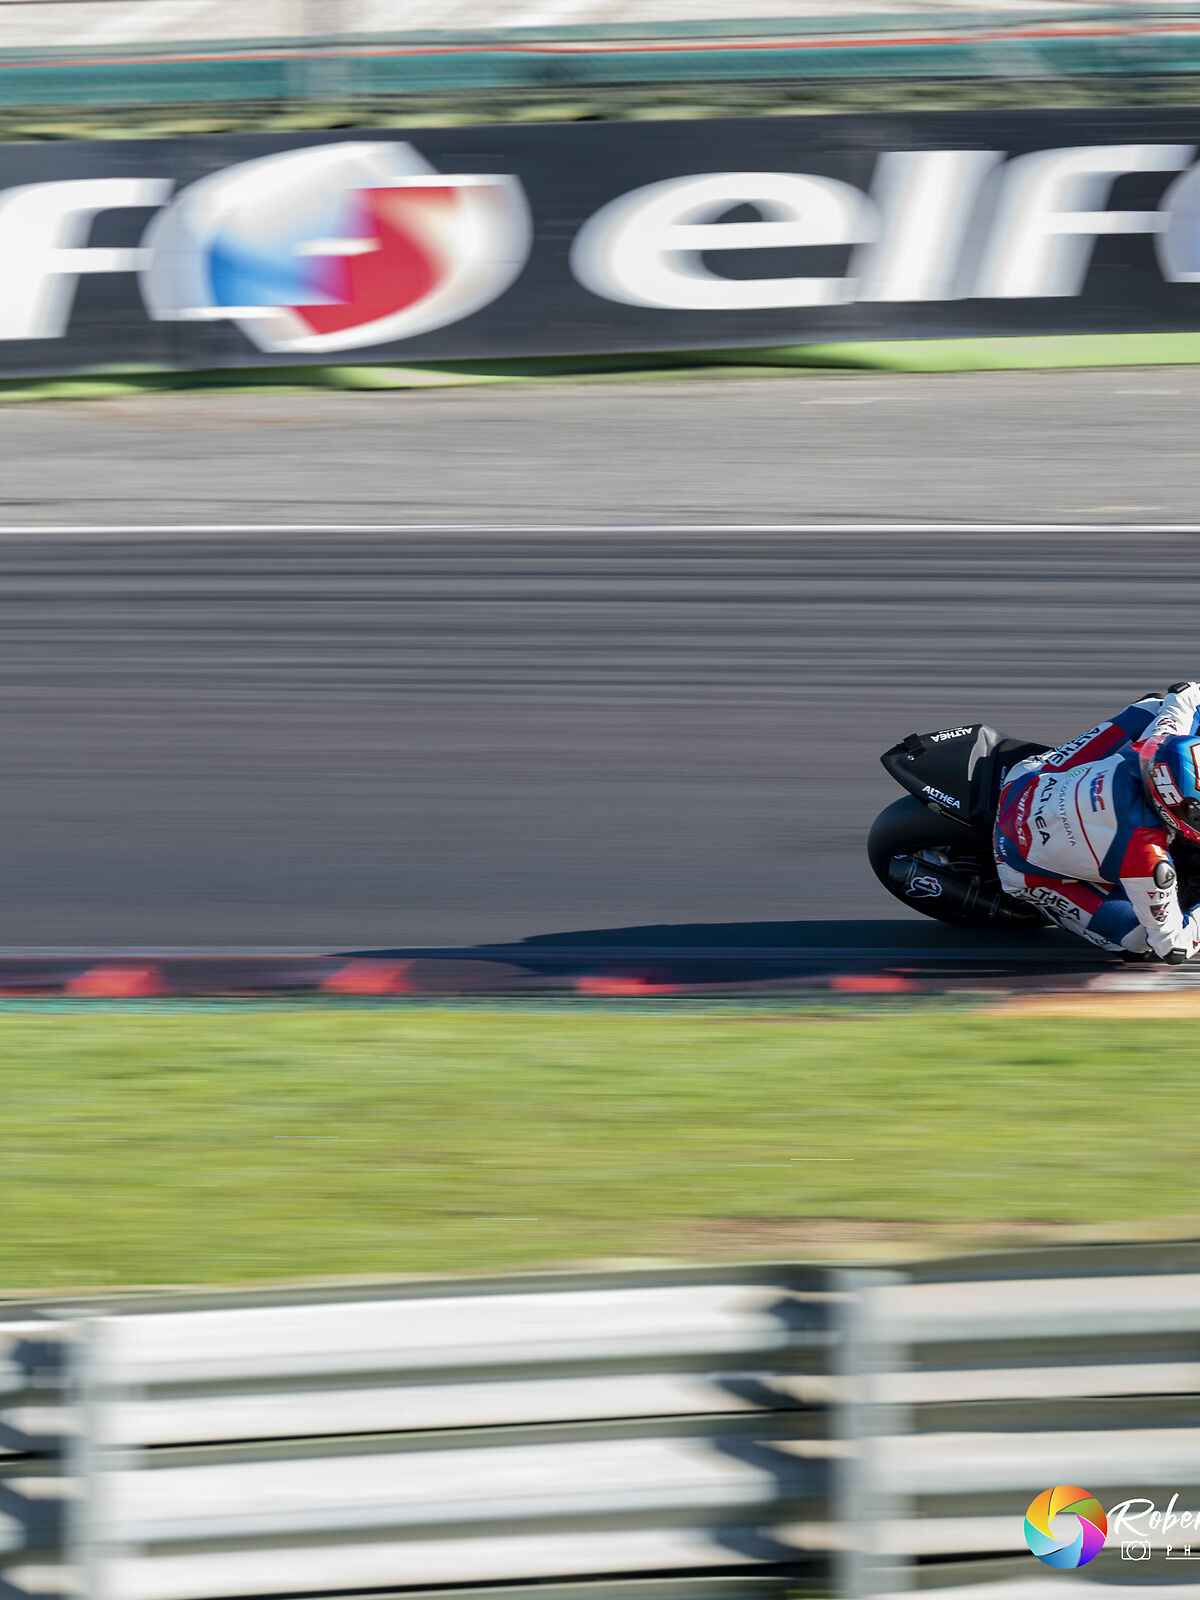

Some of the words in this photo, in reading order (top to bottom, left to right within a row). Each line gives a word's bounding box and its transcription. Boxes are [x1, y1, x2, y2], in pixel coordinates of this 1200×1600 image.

[570, 143, 1196, 310] elf
[930, 727, 973, 743] ALTHEA
[922, 785, 961, 809] ALTHEA
[1151, 762, 1184, 807] 36
